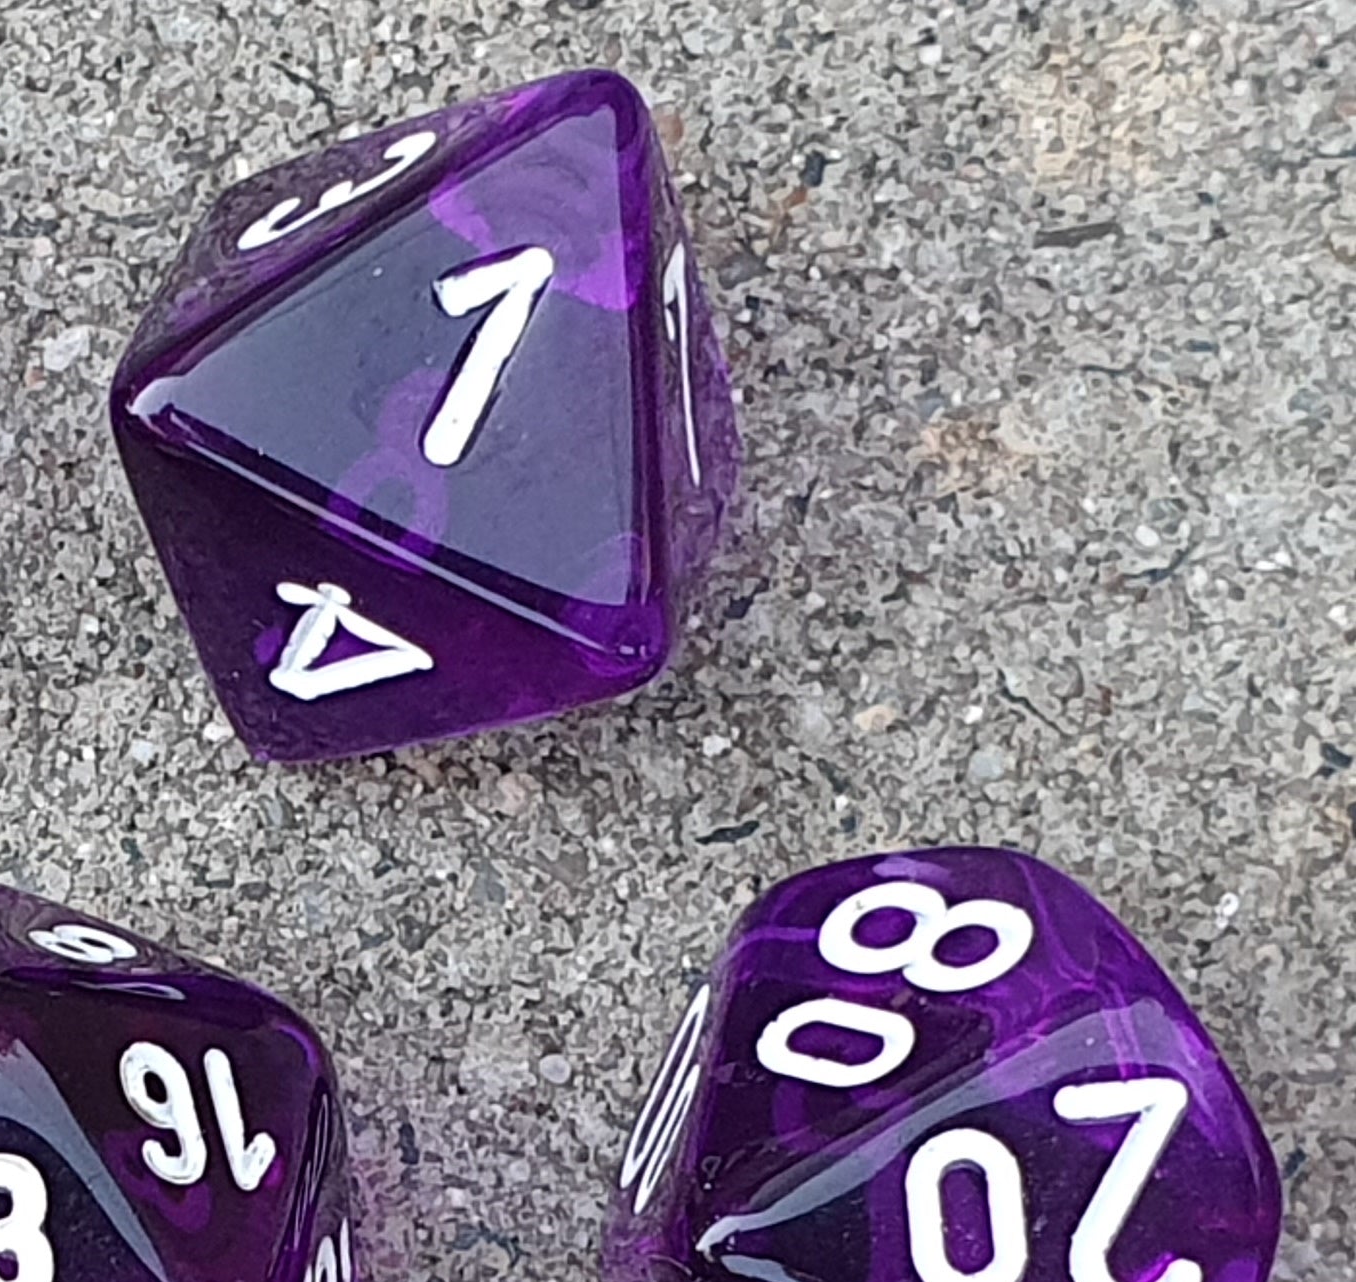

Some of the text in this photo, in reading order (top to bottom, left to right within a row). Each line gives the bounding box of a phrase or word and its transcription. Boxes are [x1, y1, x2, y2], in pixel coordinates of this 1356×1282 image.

[237, 131, 436, 250] 3
[270, 582, 433, 700] 4
[756, 881, 1033, 1087] 80
